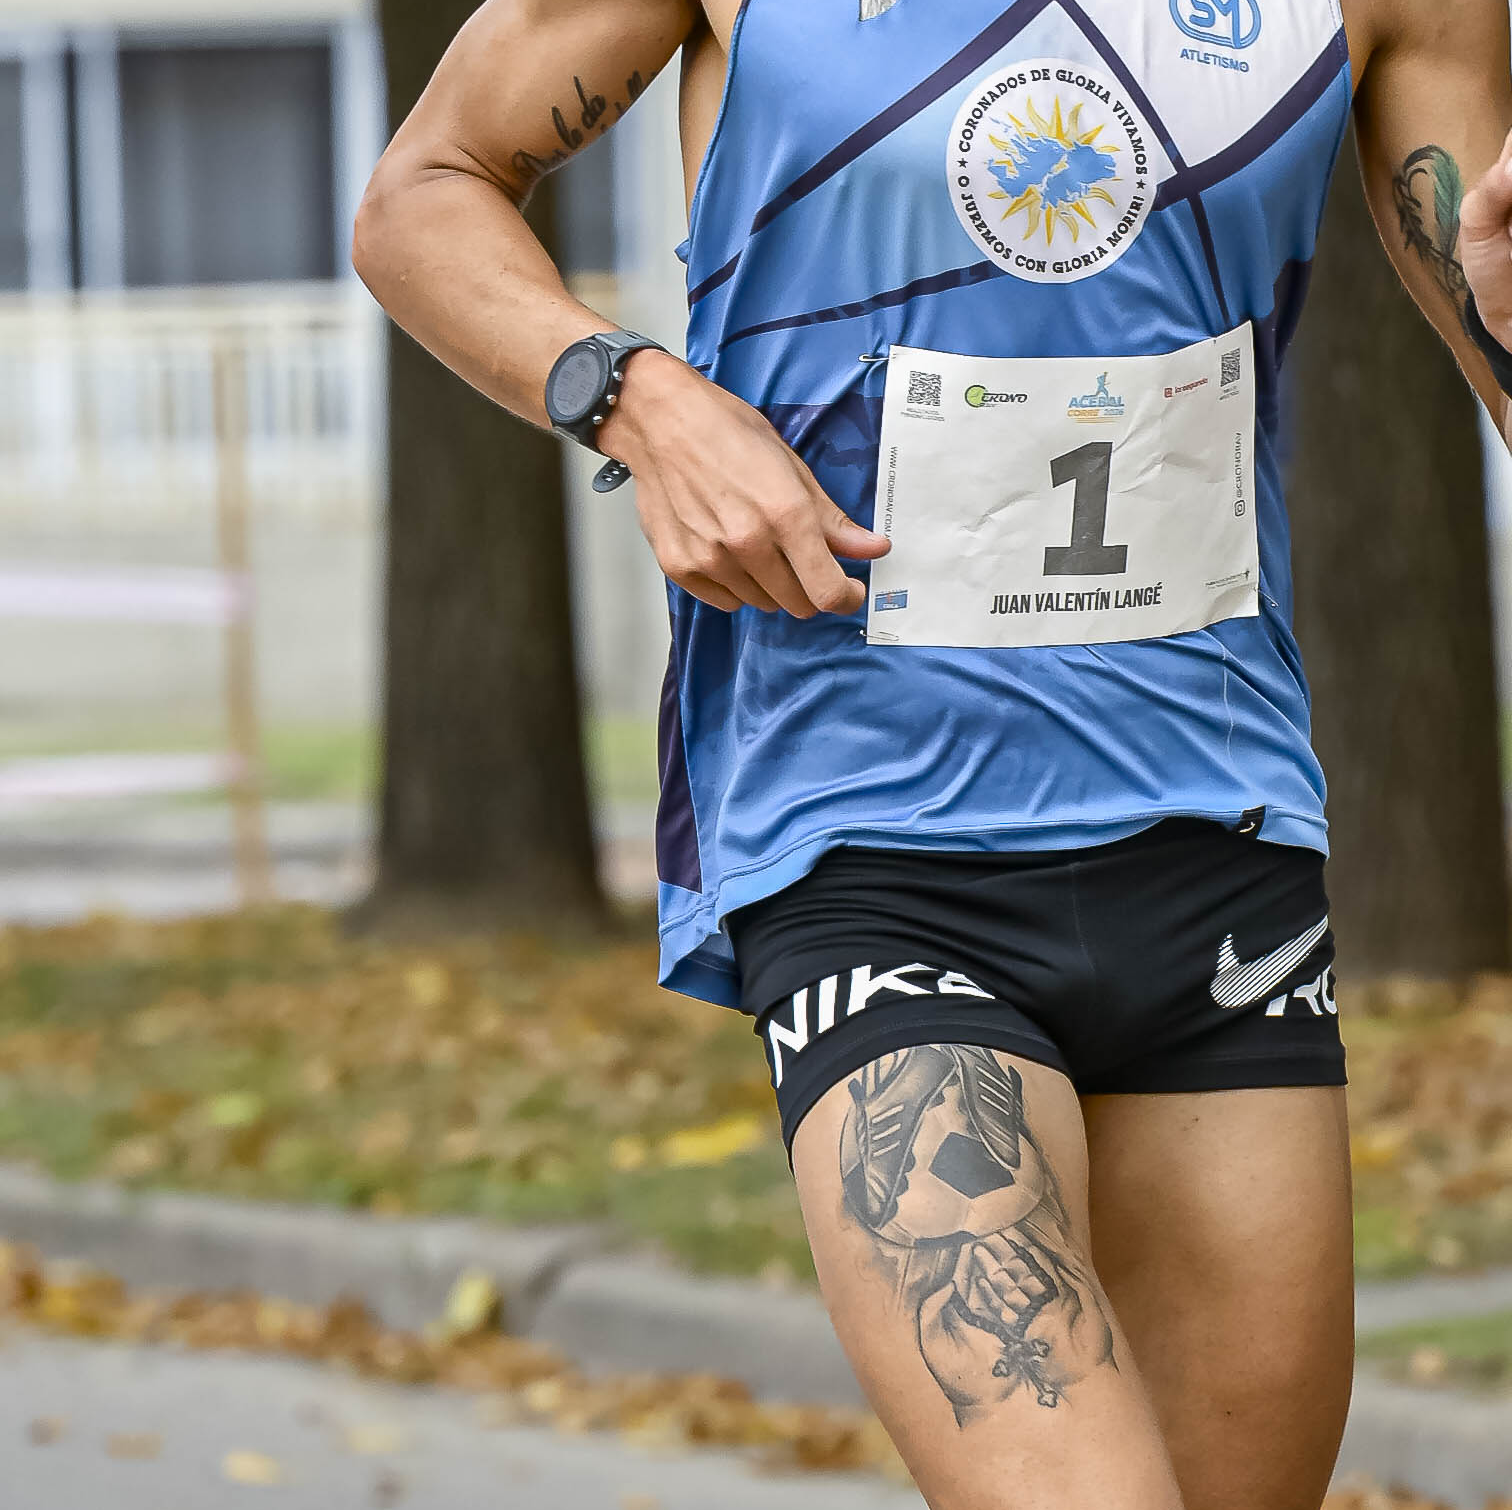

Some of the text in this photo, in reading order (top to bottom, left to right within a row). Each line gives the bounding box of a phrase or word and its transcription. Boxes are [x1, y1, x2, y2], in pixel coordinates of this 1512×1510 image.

[1180, 48, 1250, 73] ATLETISMO
[958, 68, 1148, 175] CORONADOS DE GLORIA VIVAMOS
[958, 176, 970, 188] O
[961, 193, 1014, 261] JUREMOS
[1015, 254, 1047, 273] CON
[1052, 245, 1109, 274] GLORIA
[1042, 440, 1128, 577] 1
[989, 582, 1163, 616] JUAN VALENTÍN LANGÉ
